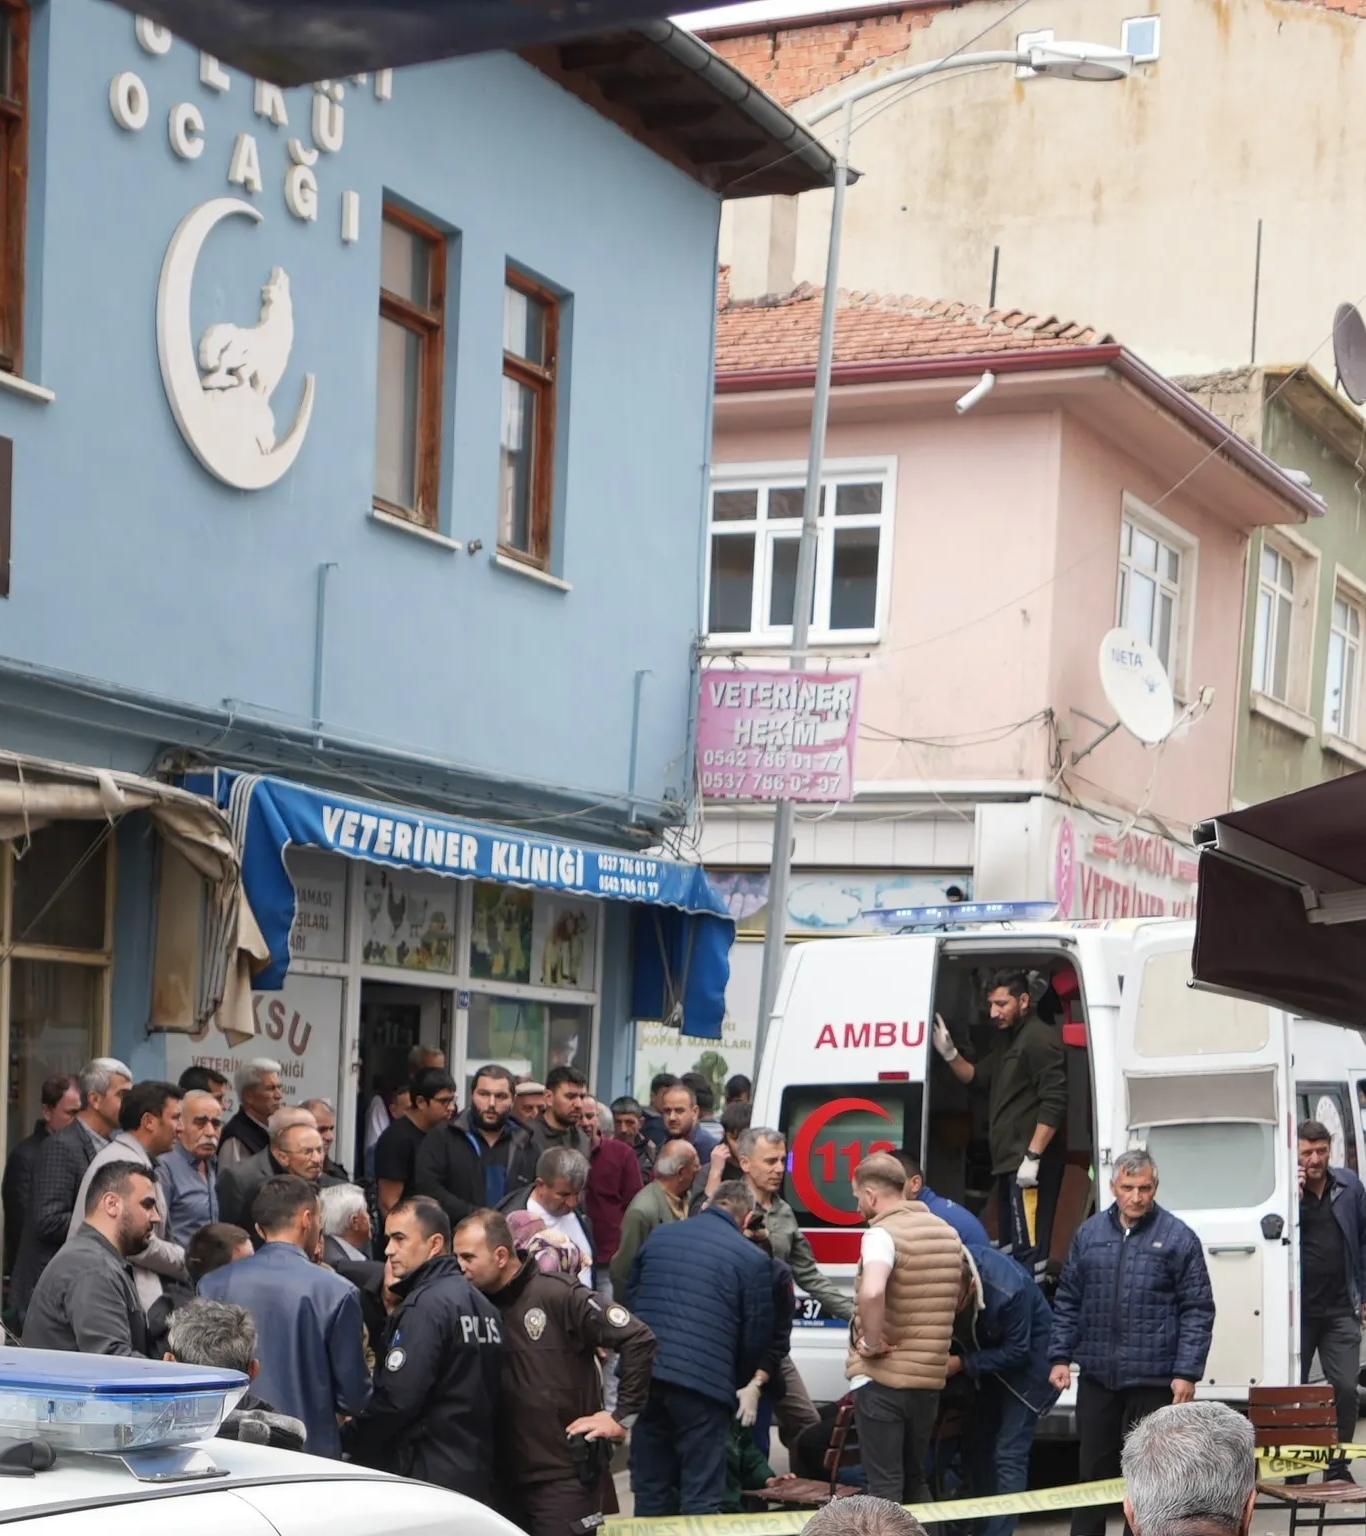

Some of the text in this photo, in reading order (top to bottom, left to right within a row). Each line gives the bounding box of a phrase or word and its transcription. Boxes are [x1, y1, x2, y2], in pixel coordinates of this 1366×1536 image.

[110, 70, 360, 243] OCAĞI
[1111, 647, 1143, 668] NETA
[709, 677, 851, 712] VETERİNER
[735, 715, 818, 747] HEKİM
[704, 750, 747, 767] 0542
[754, 751, 785, 769] 786
[703, 772, 746, 789] 0537
[753, 773, 784, 791] 786
[322, 803, 584, 887] VETERİNER KLİNİĞİ
[815, 1021, 925, 1050] AMBU
[803, 1299, 822, 1319] 37
